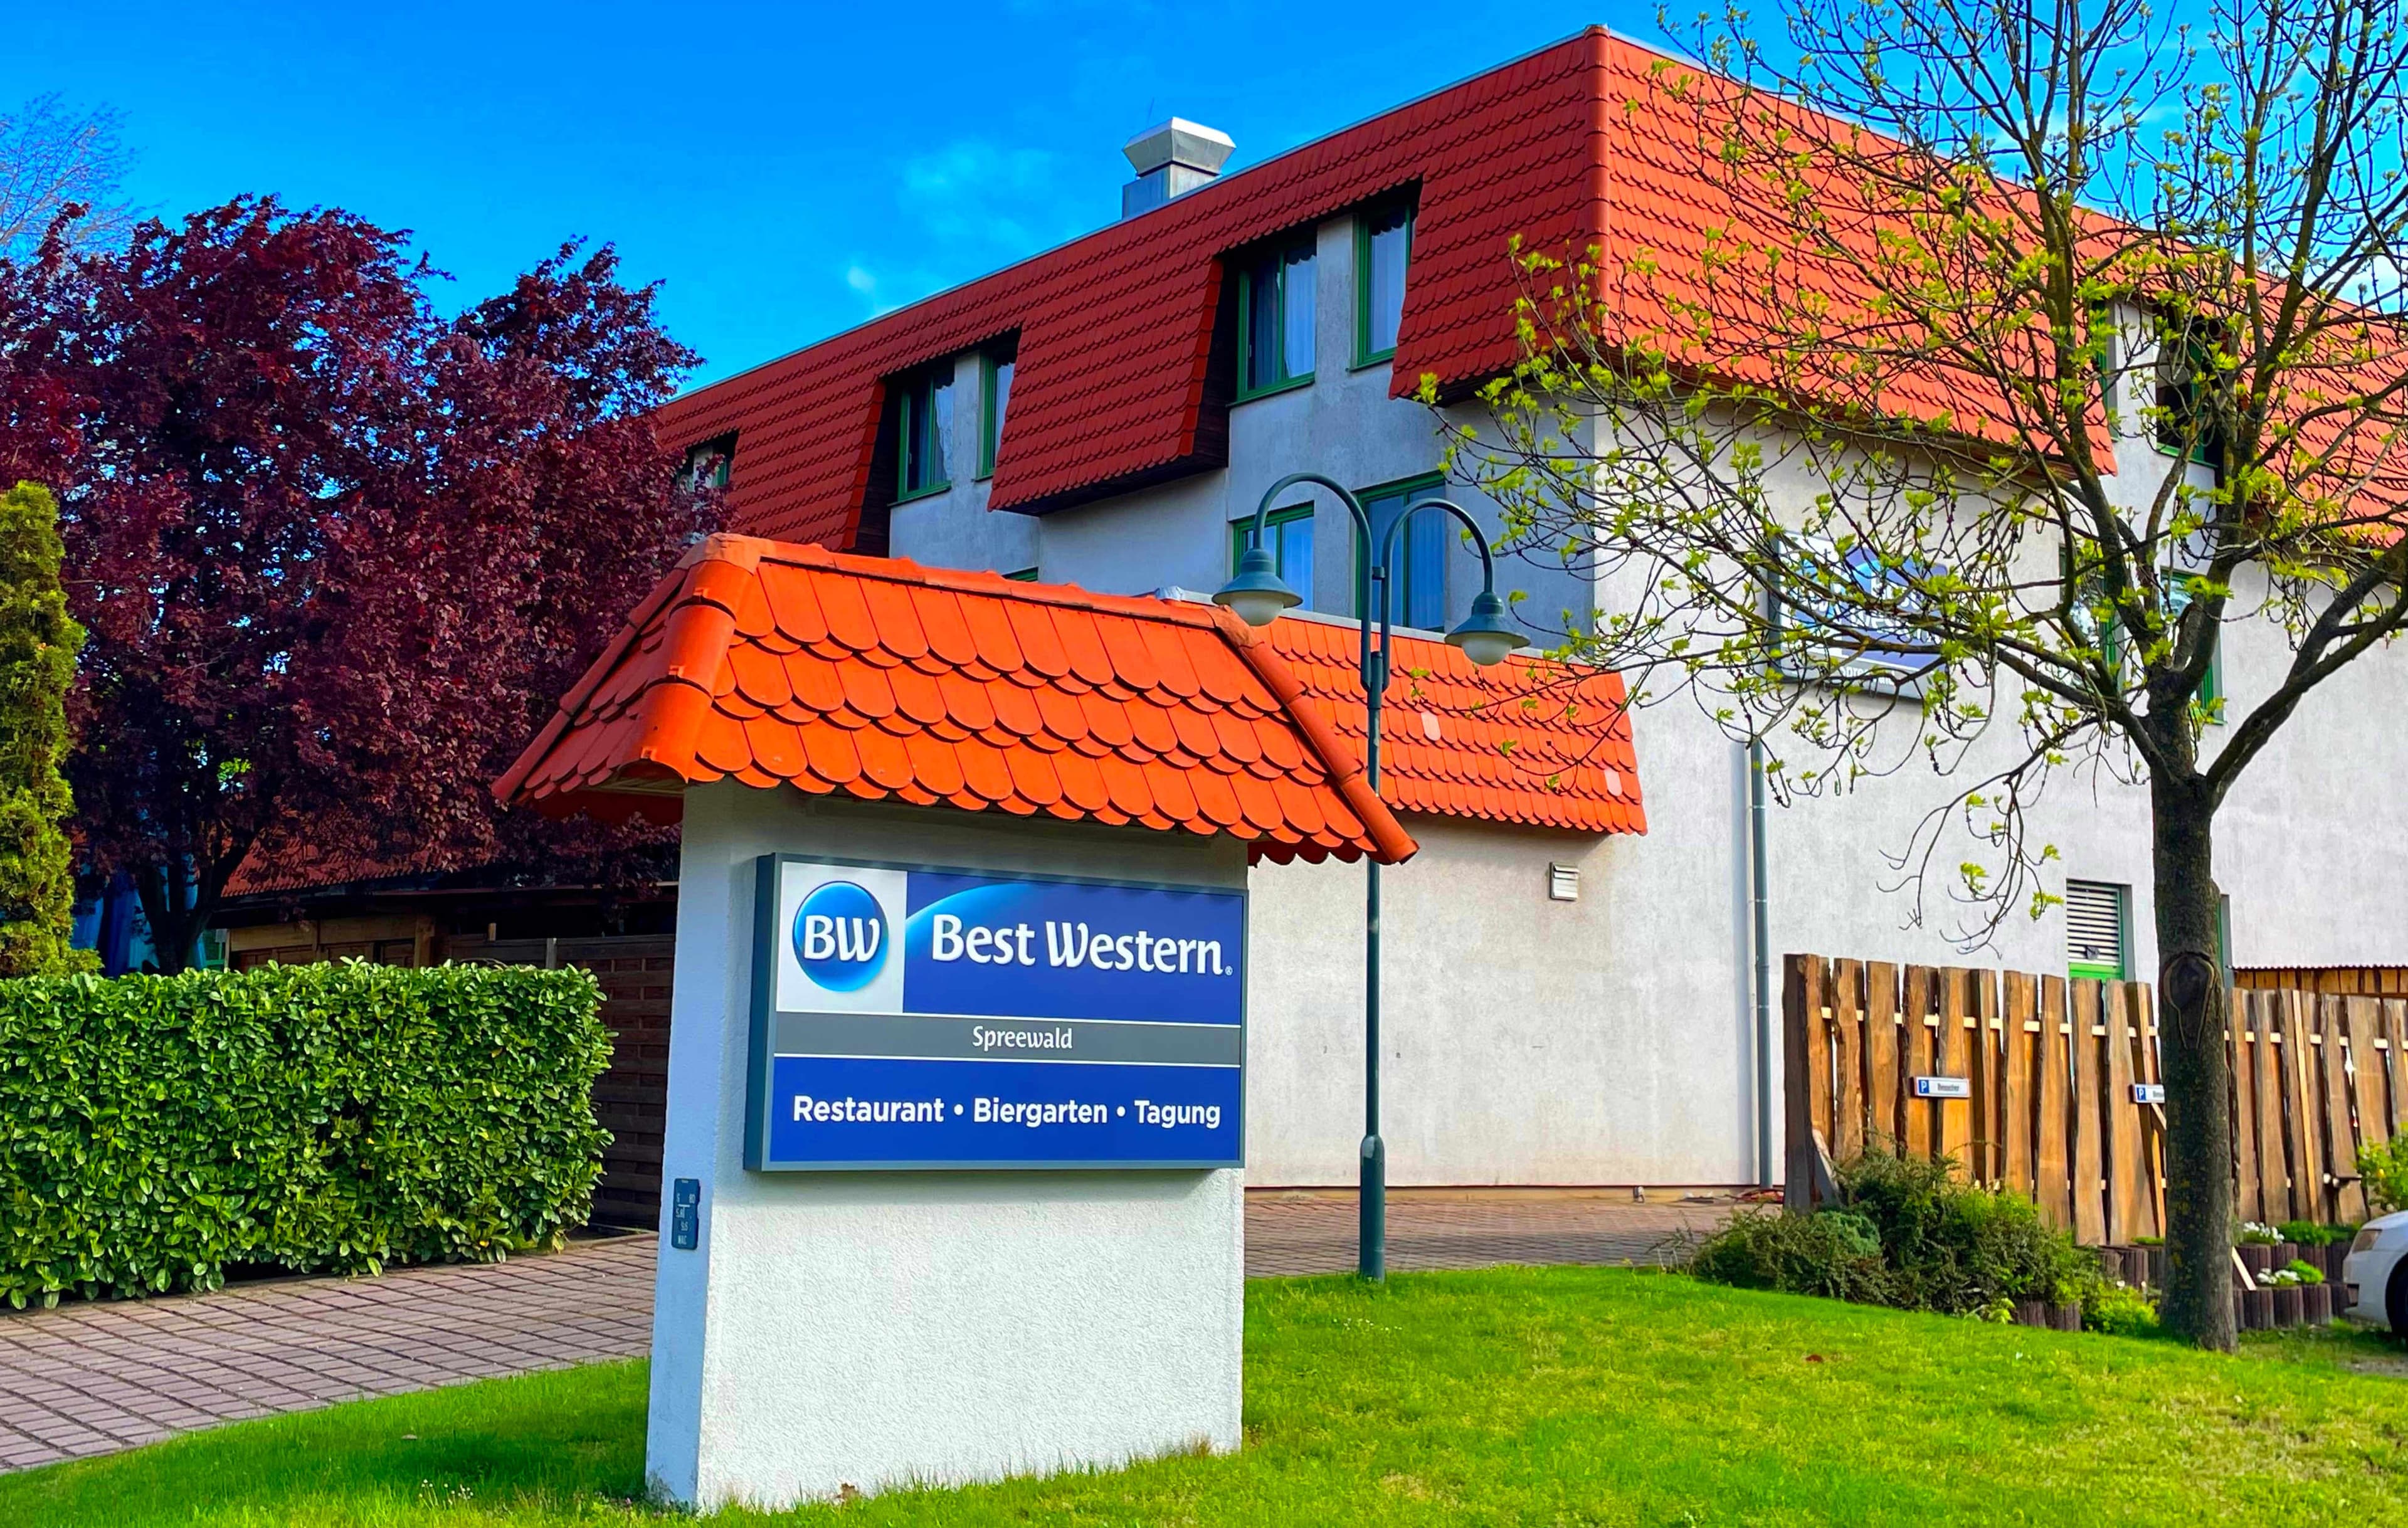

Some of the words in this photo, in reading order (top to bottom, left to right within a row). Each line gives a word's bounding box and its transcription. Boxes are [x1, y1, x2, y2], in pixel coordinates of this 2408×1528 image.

[803, 914, 881, 962] BW
[931, 913, 1036, 966] Best
[972, 1025, 1073, 1052] Spreewald
[793, 1095, 945, 1122] Restaurant
[973, 1097, 1108, 1128] Biergarten
[1134, 1099, 1221, 1129] Tagung
